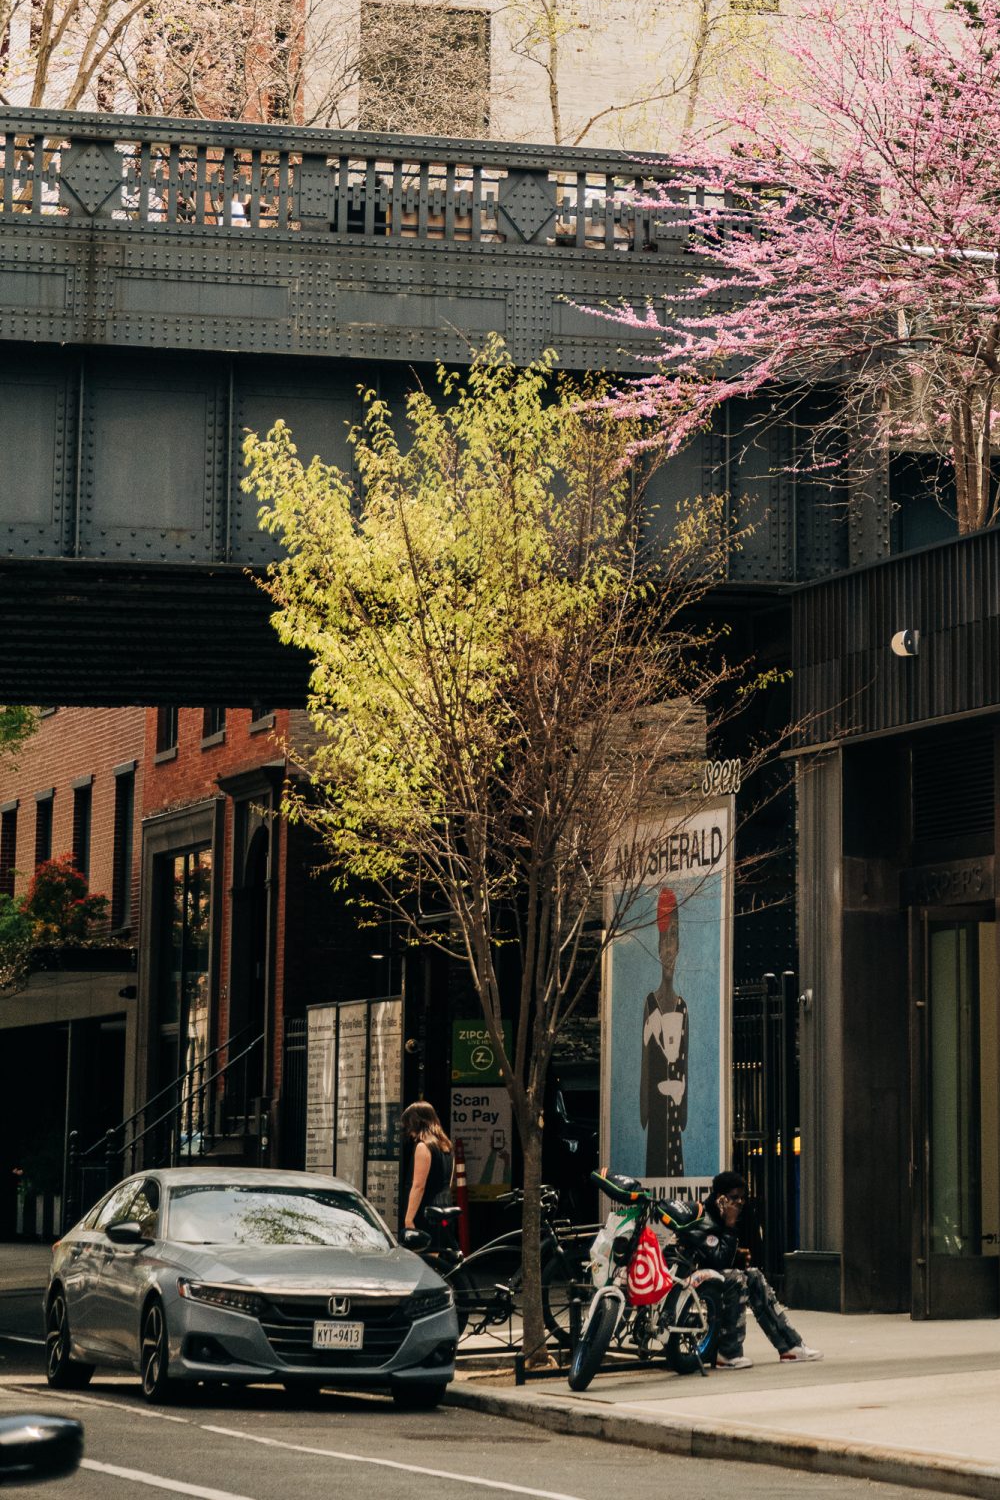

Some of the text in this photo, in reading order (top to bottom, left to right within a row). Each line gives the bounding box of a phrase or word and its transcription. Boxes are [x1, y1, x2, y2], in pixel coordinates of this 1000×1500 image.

[702, 758, 742, 797] seen
[647, 826, 723, 876] SHERALD
[453, 1093, 490, 1107] Scan
[452, 1109, 499, 1125] to Pay
